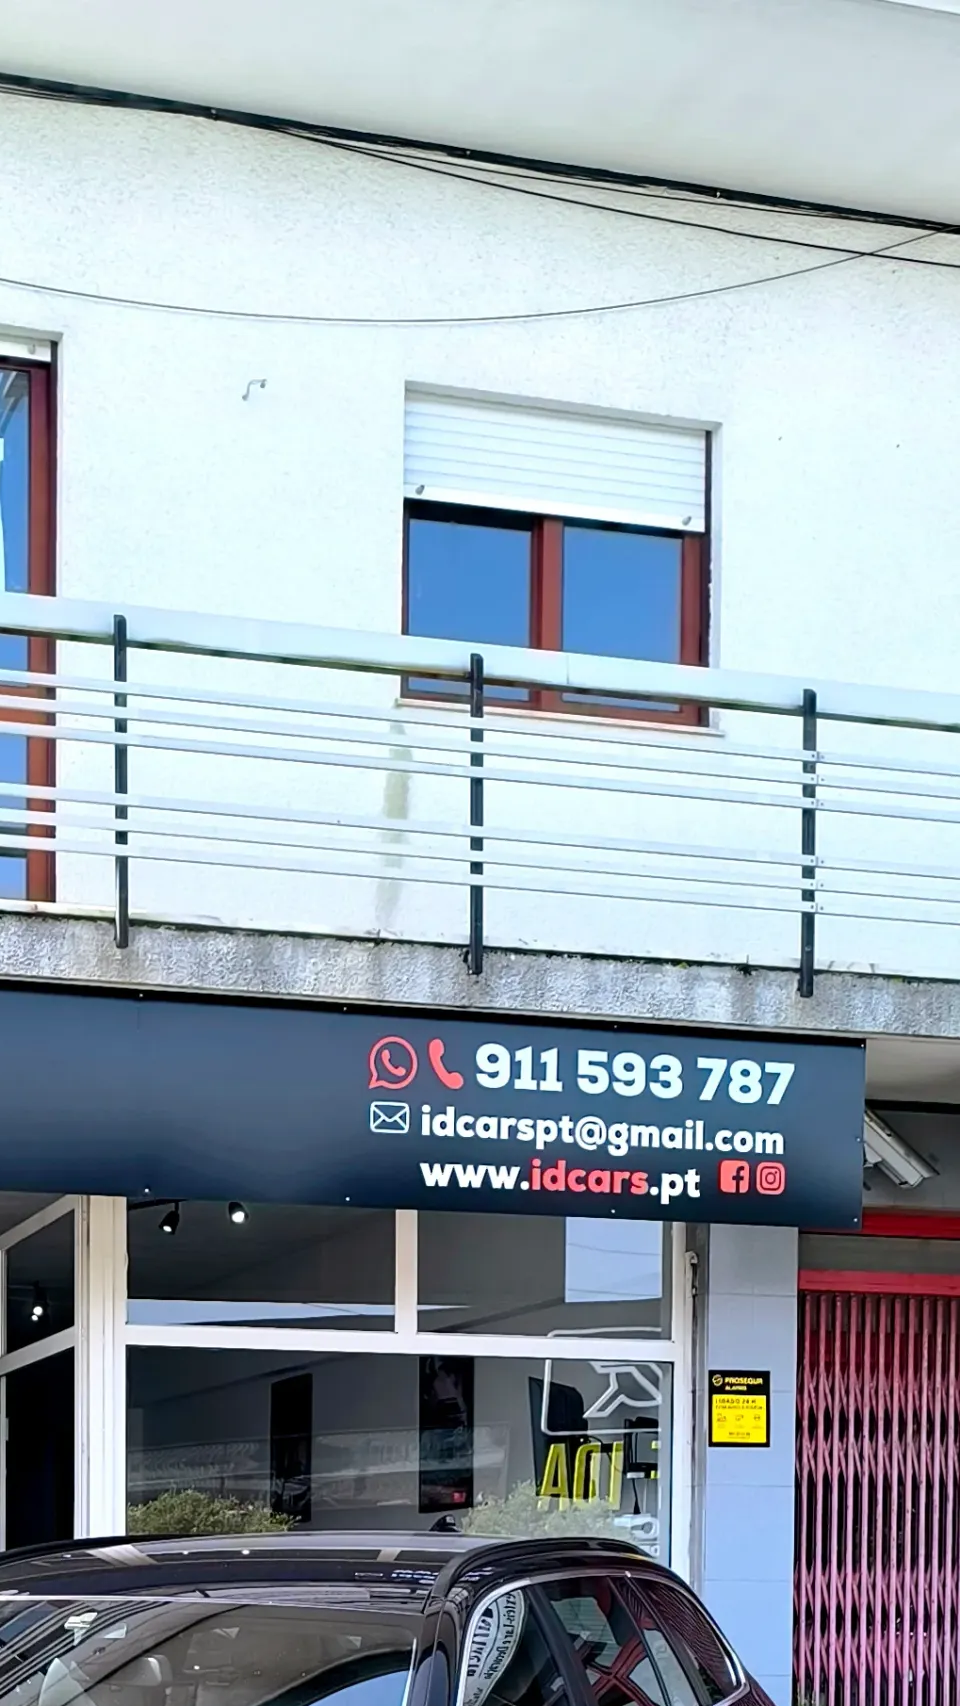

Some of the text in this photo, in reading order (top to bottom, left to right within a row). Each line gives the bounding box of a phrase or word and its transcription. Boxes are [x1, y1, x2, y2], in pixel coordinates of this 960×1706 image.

[475, 1042, 796, 1105] 911 593 787
[420, 1105, 784, 1156] idcarspt@gmail.com
[420, 1158, 701, 1204] www.idcars.pt
